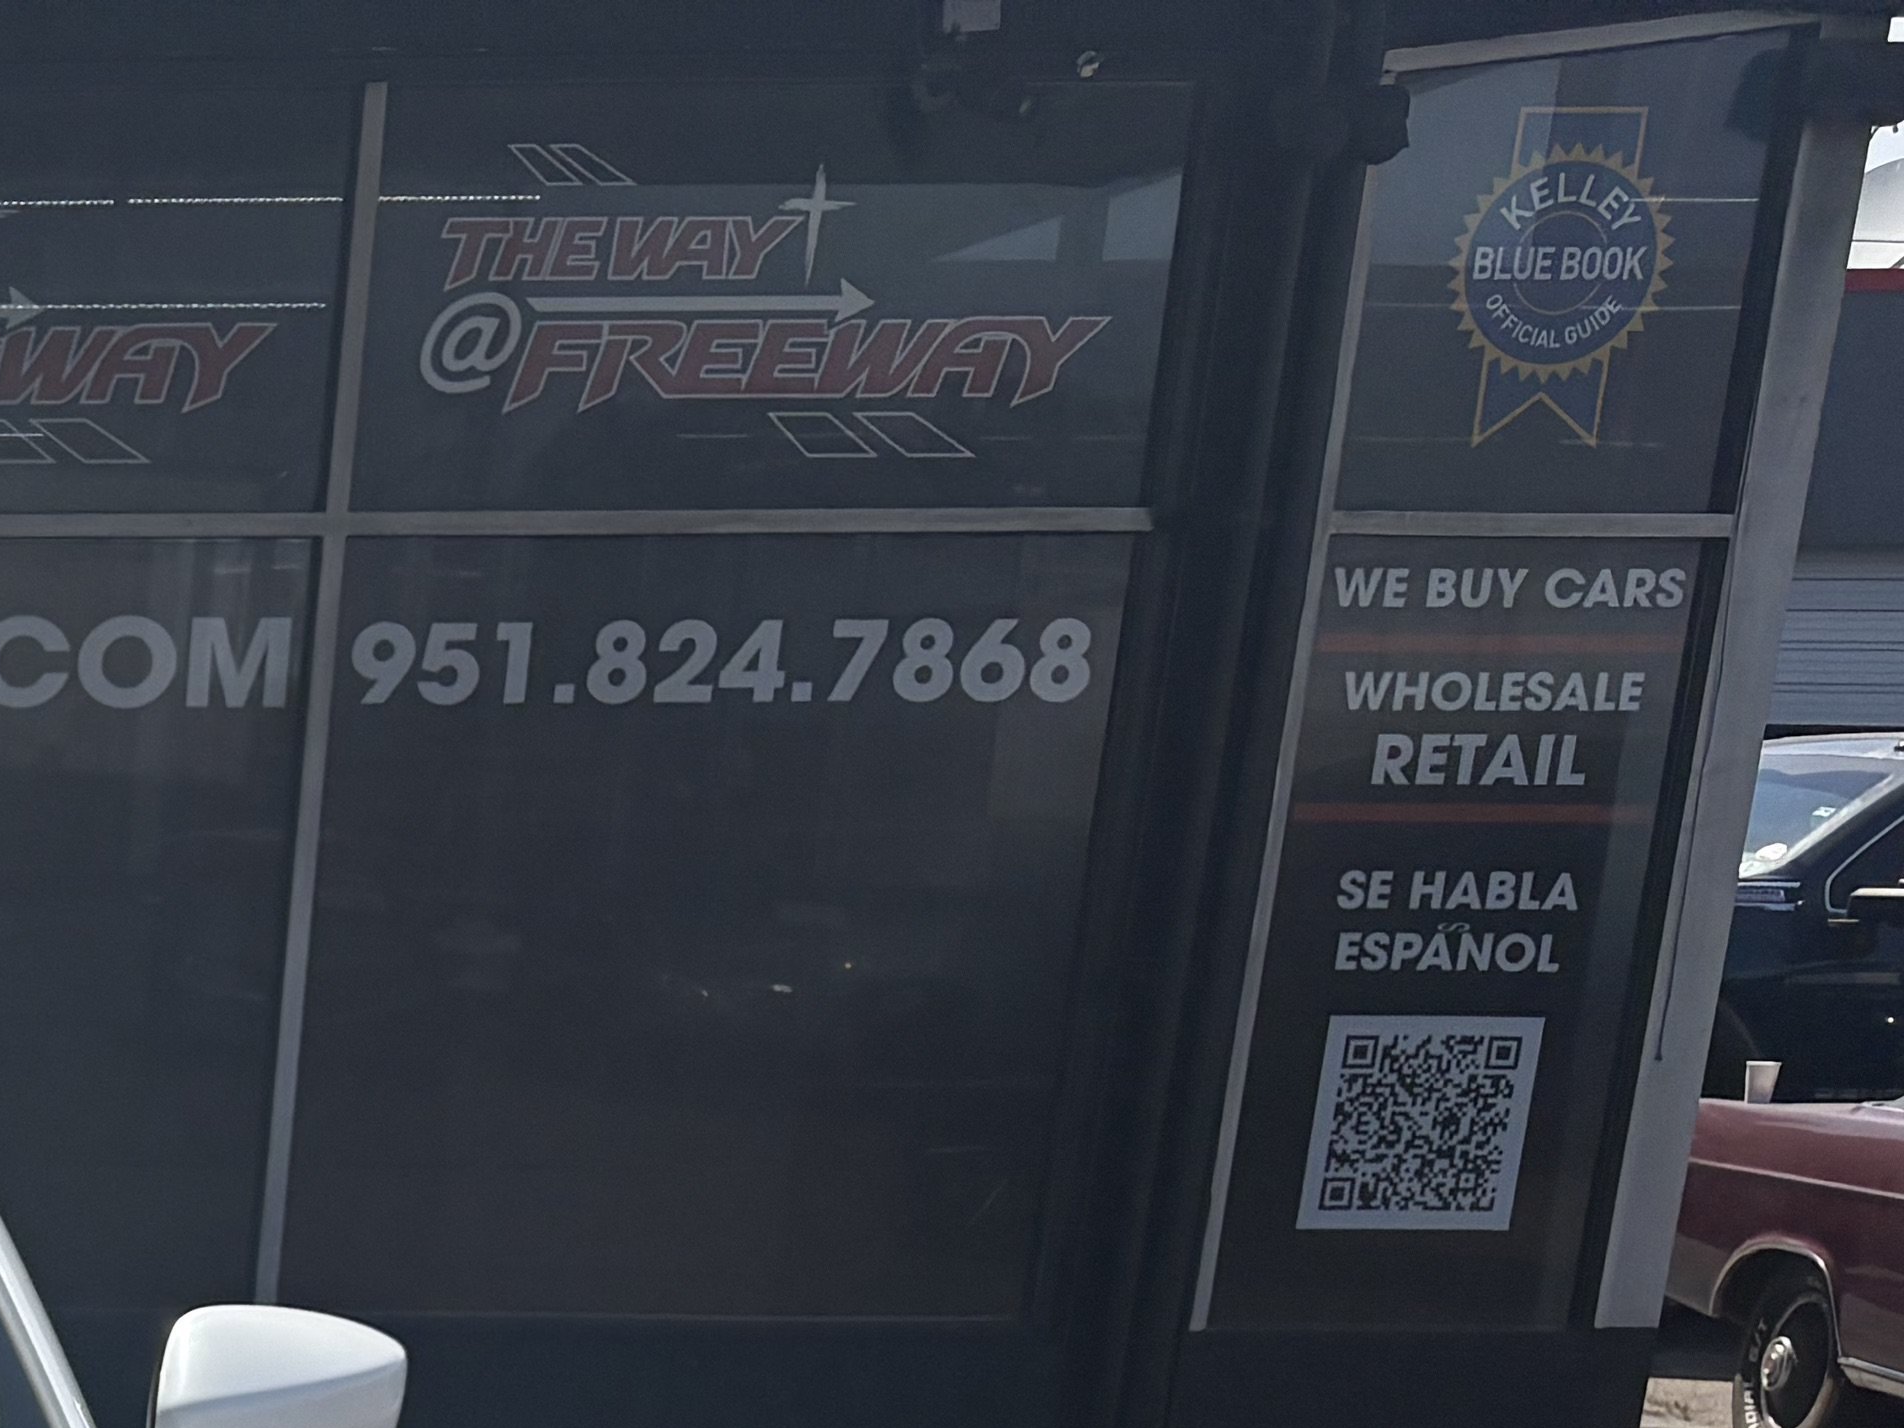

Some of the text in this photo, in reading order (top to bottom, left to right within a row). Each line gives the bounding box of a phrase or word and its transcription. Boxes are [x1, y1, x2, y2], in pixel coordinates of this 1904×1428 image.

[1499, 171, 1642, 231] KELLEY
[1472, 246, 1648, 281] BLUE BOOK
[1485, 294, 1623, 348] OFFICIAL GUIDE
[1334, 567, 1687, 610] WE BUY CARS
[350, 617, 1092, 706] 951.824.7868
[1344, 671, 1645, 712] WHOLESALE
[1370, 733, 1587, 787] RETAIL
[1337, 869, 1579, 912] SE HABLA
[1334, 921, 1560, 973] ESPAÑOL
